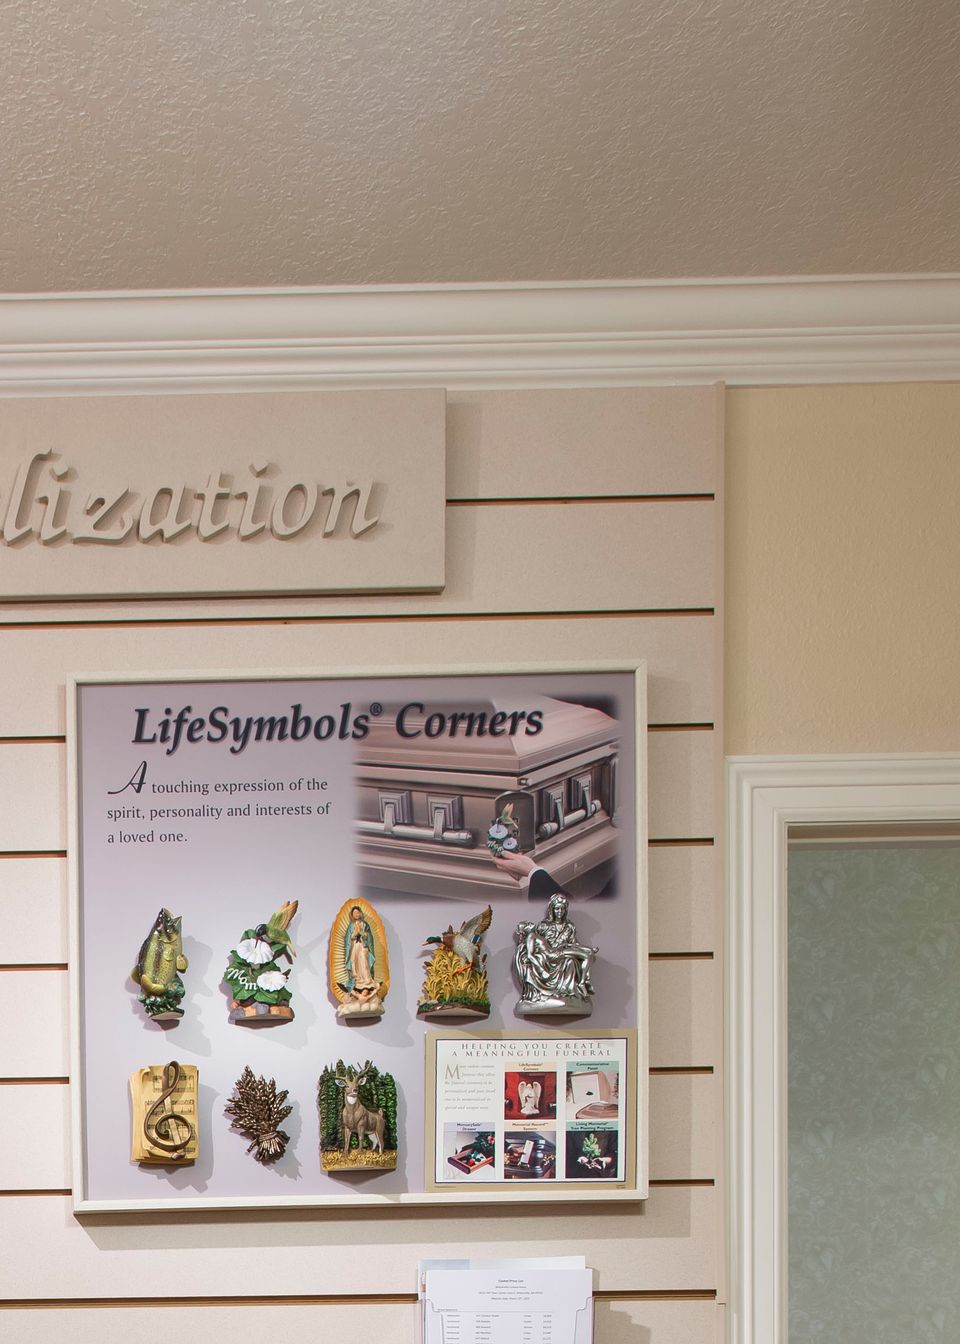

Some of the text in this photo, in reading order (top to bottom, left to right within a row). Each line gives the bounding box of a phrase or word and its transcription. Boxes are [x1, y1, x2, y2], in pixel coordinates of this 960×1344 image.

[395, 702, 545, 738] Corners
[107, 760, 329, 795] A touching expression of the
[107, 802, 333, 822] spirit, personality and interests of
[107, 830, 188, 844] a loved one.
[226, 967, 258, 991] Mom
